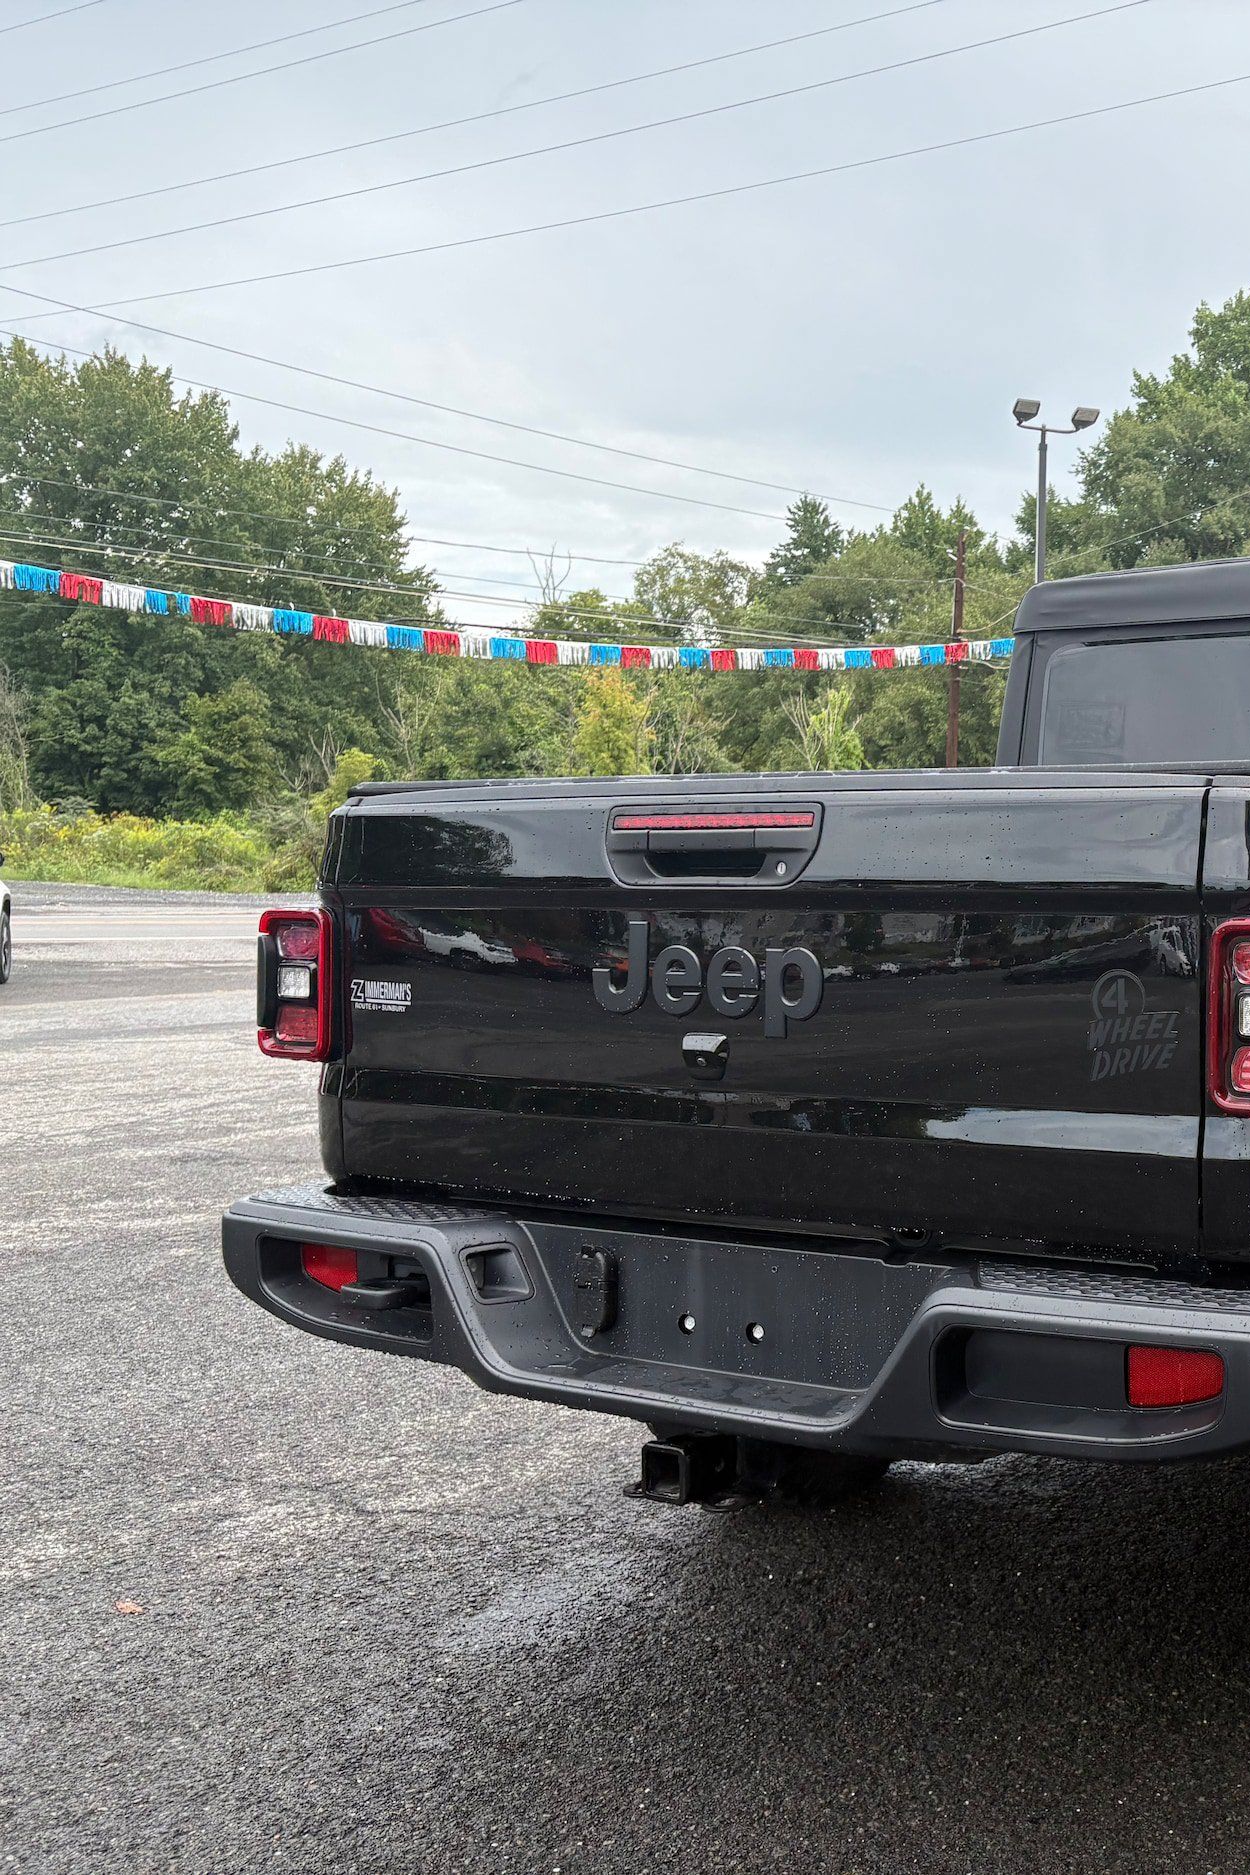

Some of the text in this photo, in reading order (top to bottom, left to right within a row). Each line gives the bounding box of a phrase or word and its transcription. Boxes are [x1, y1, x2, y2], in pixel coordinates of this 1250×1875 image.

[350, 979, 412, 1002] ZIMMERMAN'S
[592, 920, 824, 1038] Jeep
[354, 1002, 372, 1011] ROUTE
[381, 1004, 407, 1013] SUNBURY
[1087, 1011, 1180, 1050] WHEEL
[1090, 1042, 1177, 1081] DRIVE
